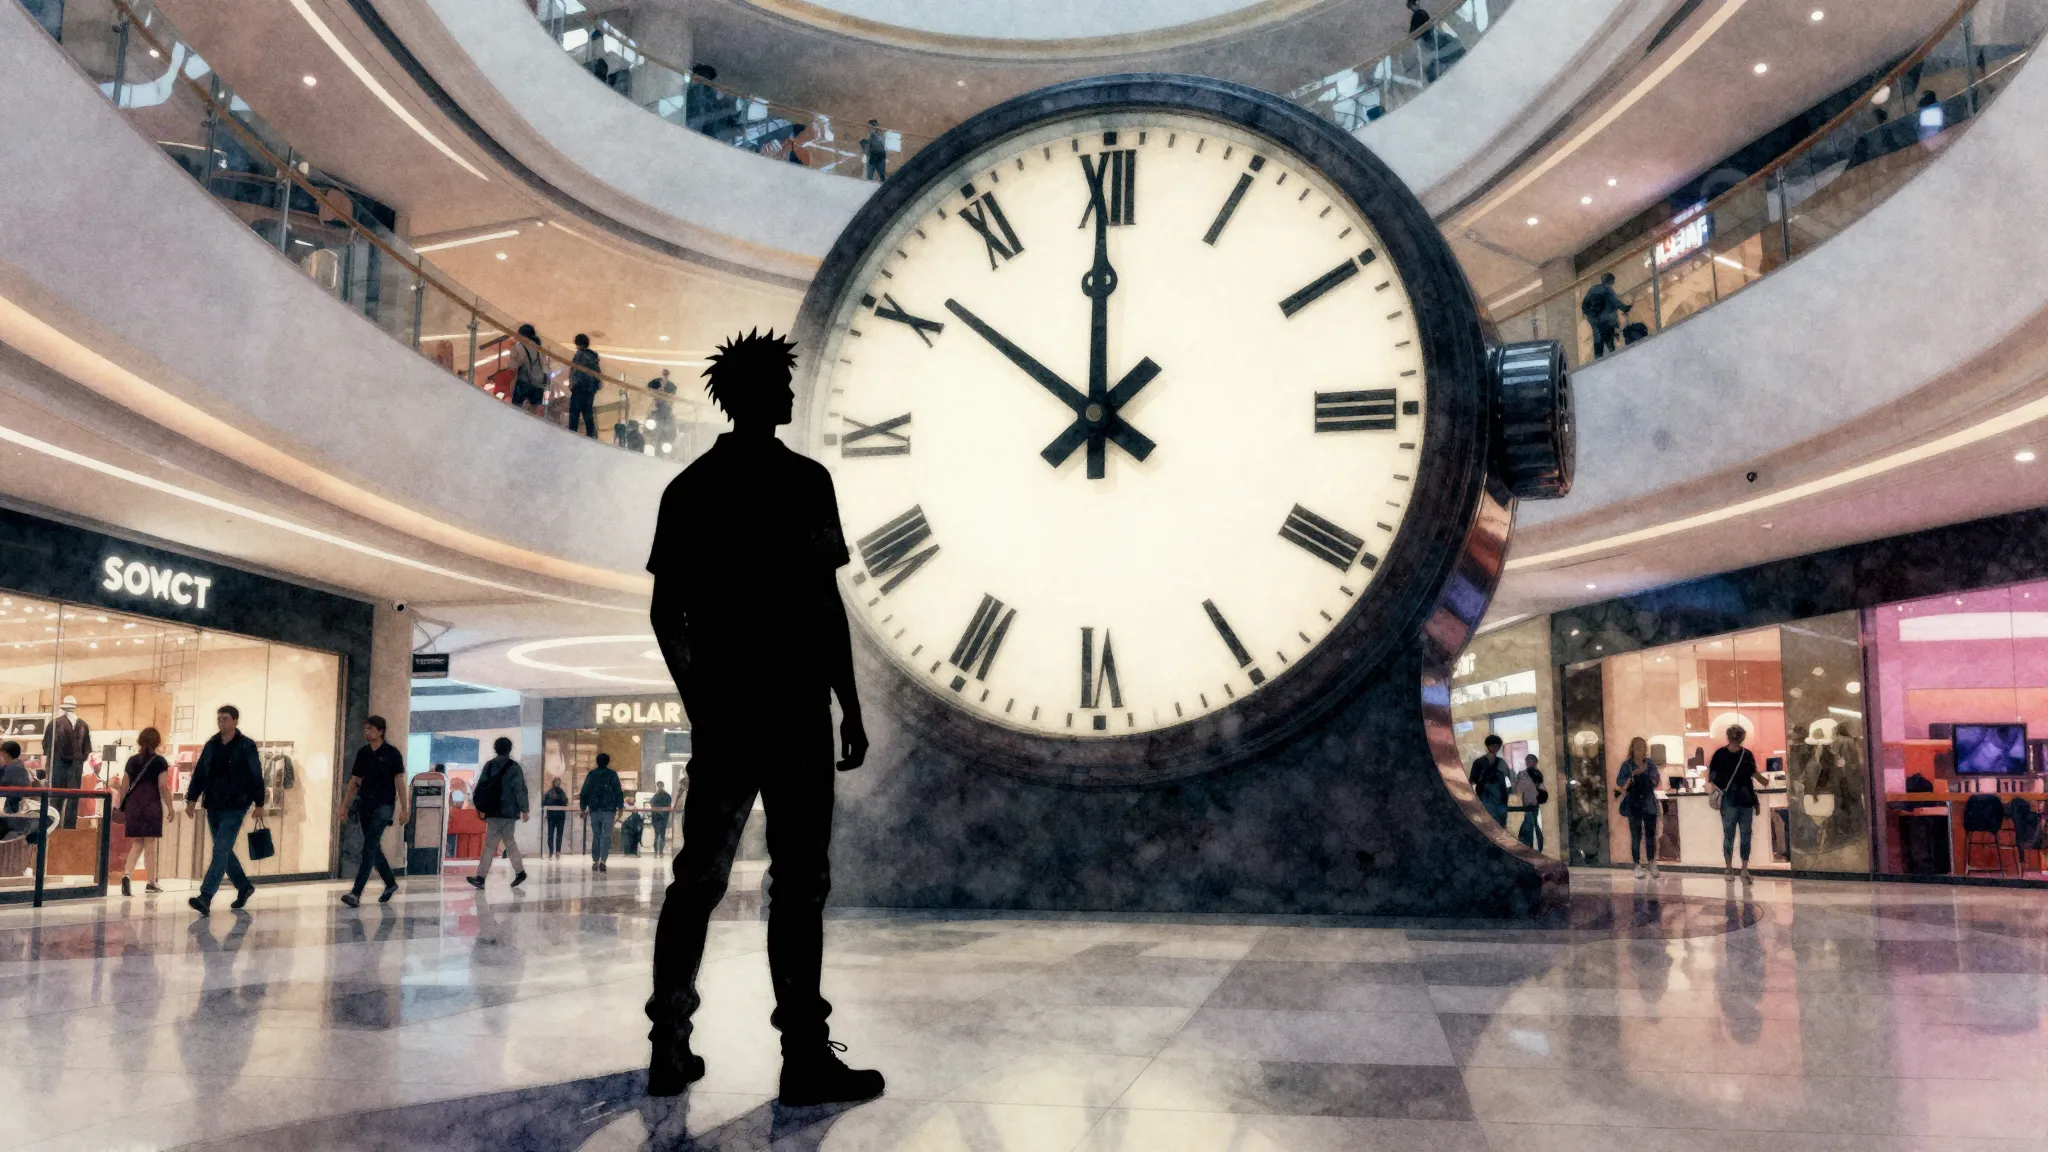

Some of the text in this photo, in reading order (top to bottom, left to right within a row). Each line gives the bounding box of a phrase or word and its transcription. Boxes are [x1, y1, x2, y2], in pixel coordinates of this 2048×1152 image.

[957, 191, 1025, 271] XI
[874, 292, 945, 349] X
[1314, 388, 1396, 433] III
[595, 702, 681, 724] FOLAR
